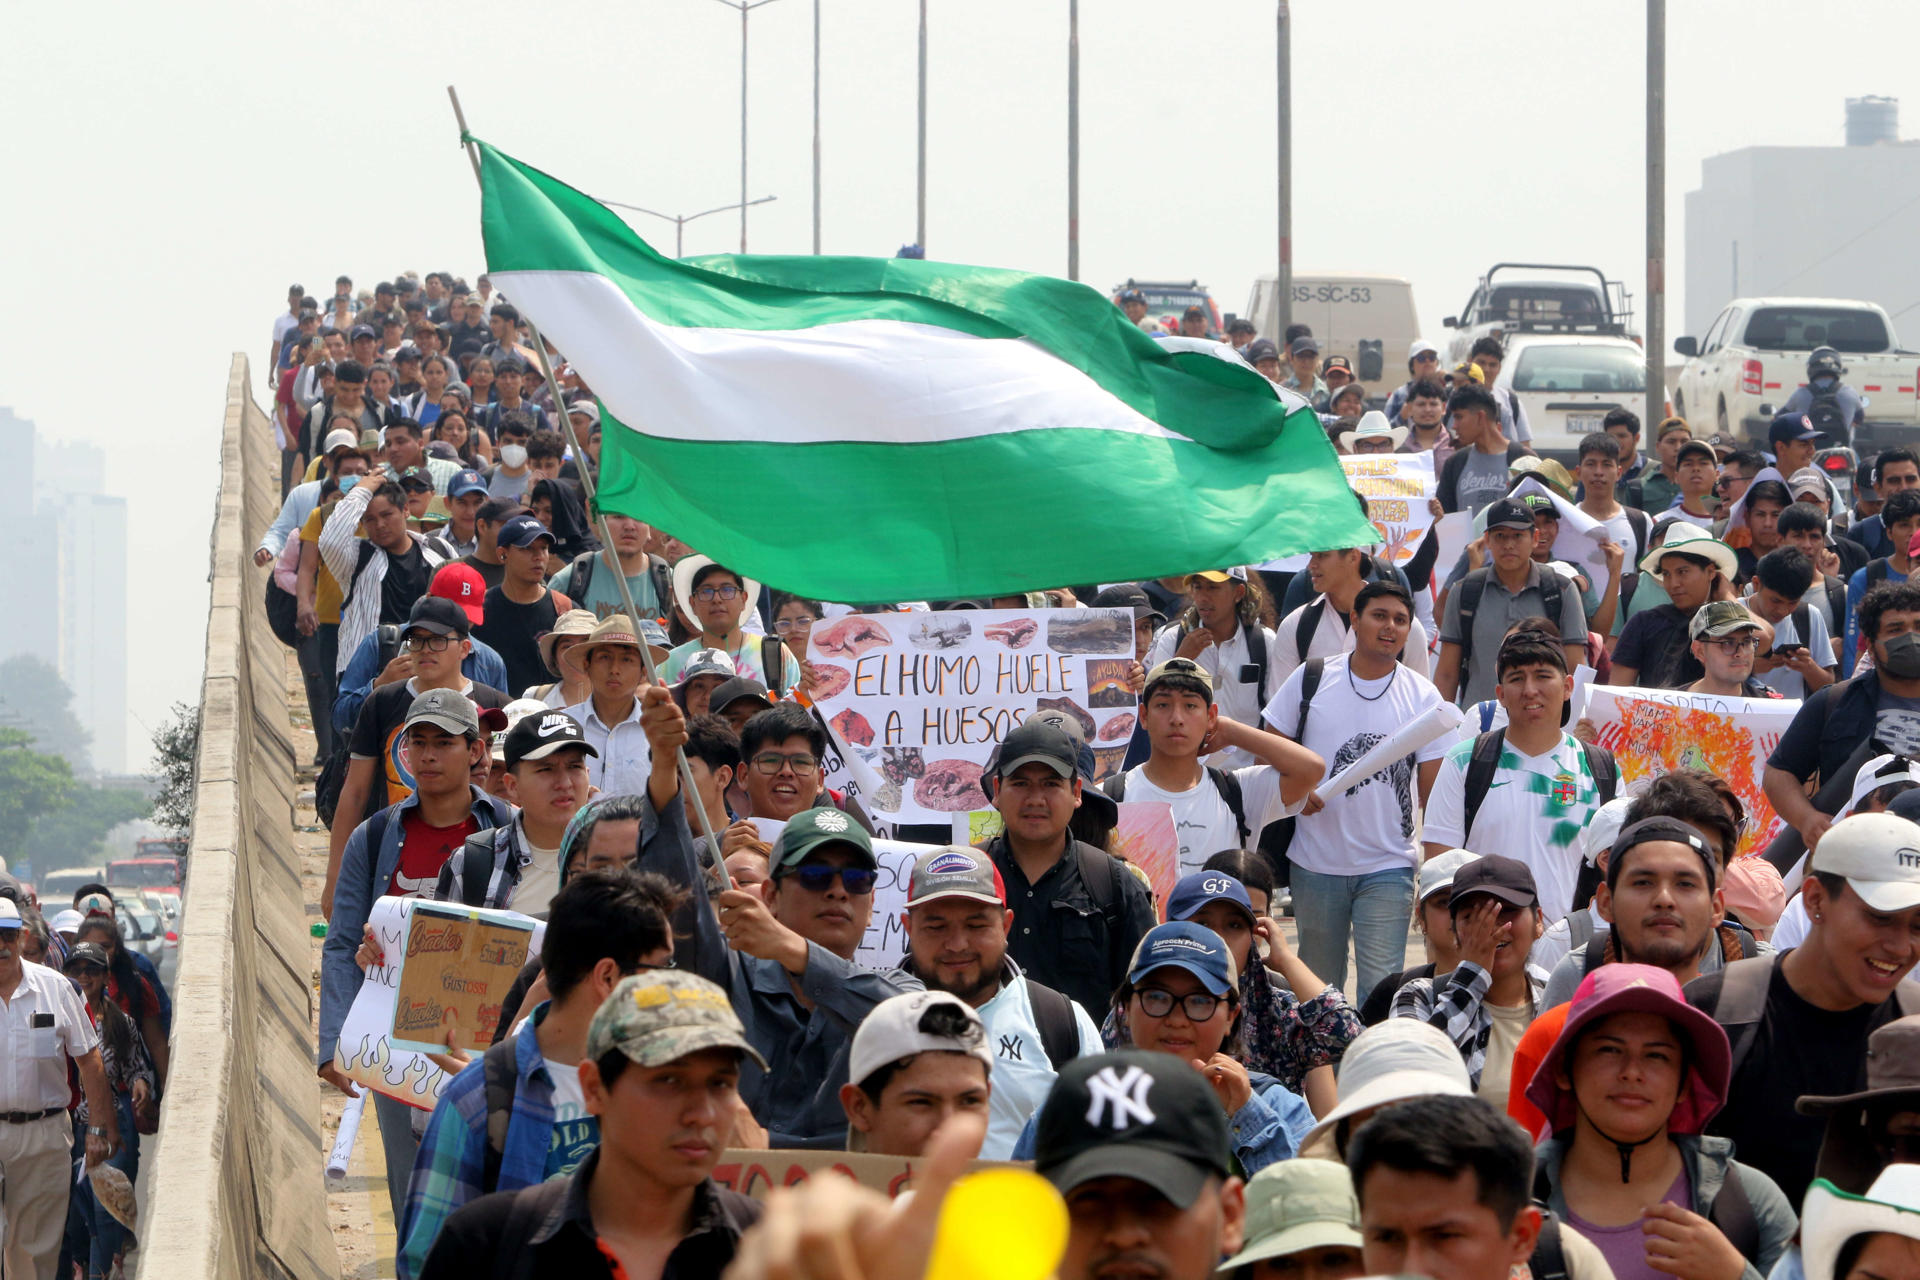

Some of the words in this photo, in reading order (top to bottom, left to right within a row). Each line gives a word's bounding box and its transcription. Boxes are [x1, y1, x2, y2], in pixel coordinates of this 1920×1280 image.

[461, 582, 471, 596] B
[855, 655, 890, 696] EL
[899, 654, 981, 697] HUMO
[996, 653, 1073, 695] HUELE
[542, 714, 569, 728] NIKE
[885, 710, 903, 745] A
[1000, 1034, 1023, 1060] NY
[1085, 1064, 1156, 1130] NY
